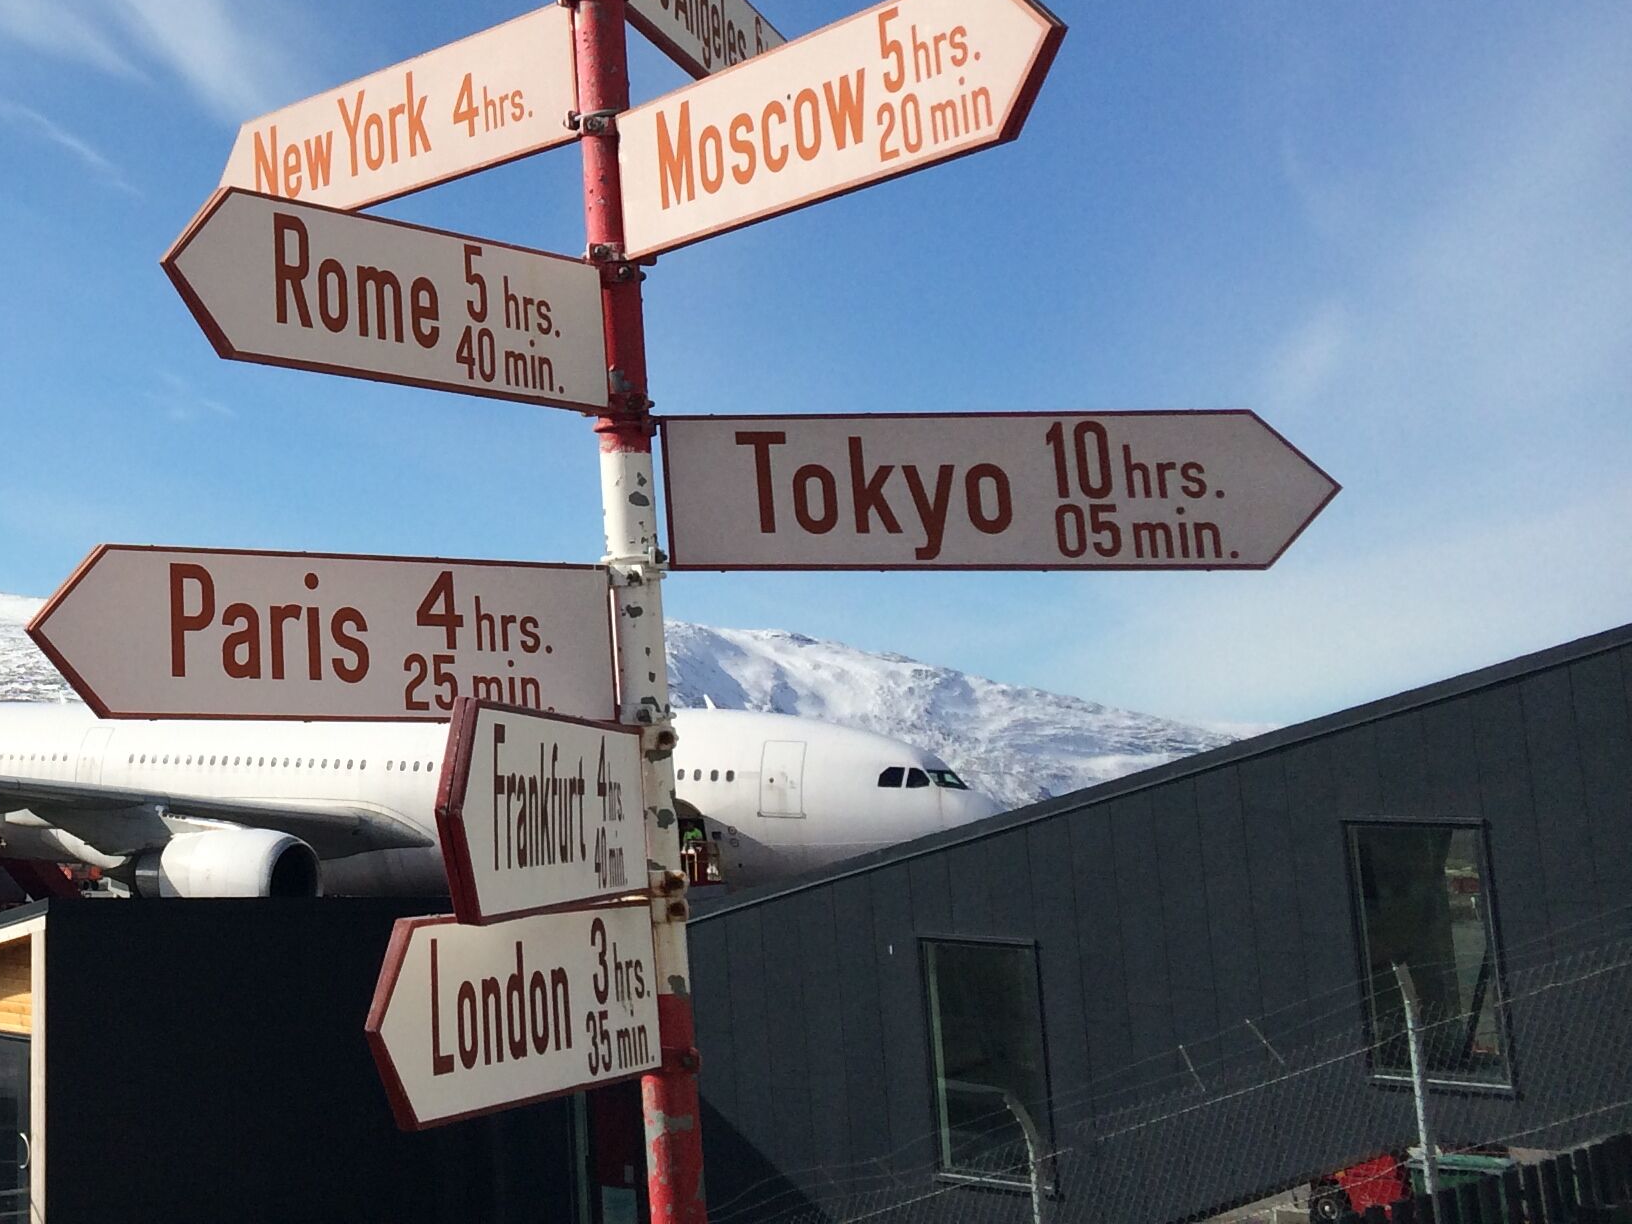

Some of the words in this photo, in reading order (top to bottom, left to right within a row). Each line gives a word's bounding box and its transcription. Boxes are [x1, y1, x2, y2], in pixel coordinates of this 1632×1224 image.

[253, 125, 334, 200] New
[337, 71, 432, 177] York
[452, 72, 480, 138] 4
[483, 85, 534, 134] hrs.
[655, 67, 866, 211] Moscow
[877, 6, 906, 94] 5
[910, 24, 982, 83] hrs.
[876, 91, 923, 163] 20
[930, 77, 994, 145] min
[273, 212, 440, 349] Rome
[463, 243, 488, 323] 5
[503, 275, 561, 338] hrs.
[455, 325, 496, 383] 40
[504, 340, 565, 394] min.
[735, 431, 1014, 560] Tokyo
[1045, 420, 1111, 501] 10
[1122, 443, 1226, 500] hrs.
[1053, 503, 1121, 559] 05
[1132, 506, 1240, 560] min.
[168, 562, 369, 684] Paris
[416, 571, 464, 650] 4
[474, 595, 553, 656] hrs.
[403, 654, 458, 711] 25
[493, 723, 587, 871] Frankfurt
[597, 735, 607, 822] 4
[594, 826, 608, 890] 40
[430, 938, 573, 1076] London
[591, 917, 609, 1005] 3
[612, 942, 651, 1003] hrs.
[586, 1010, 612, 1076] 35
[616, 1006, 655, 1070] min.
